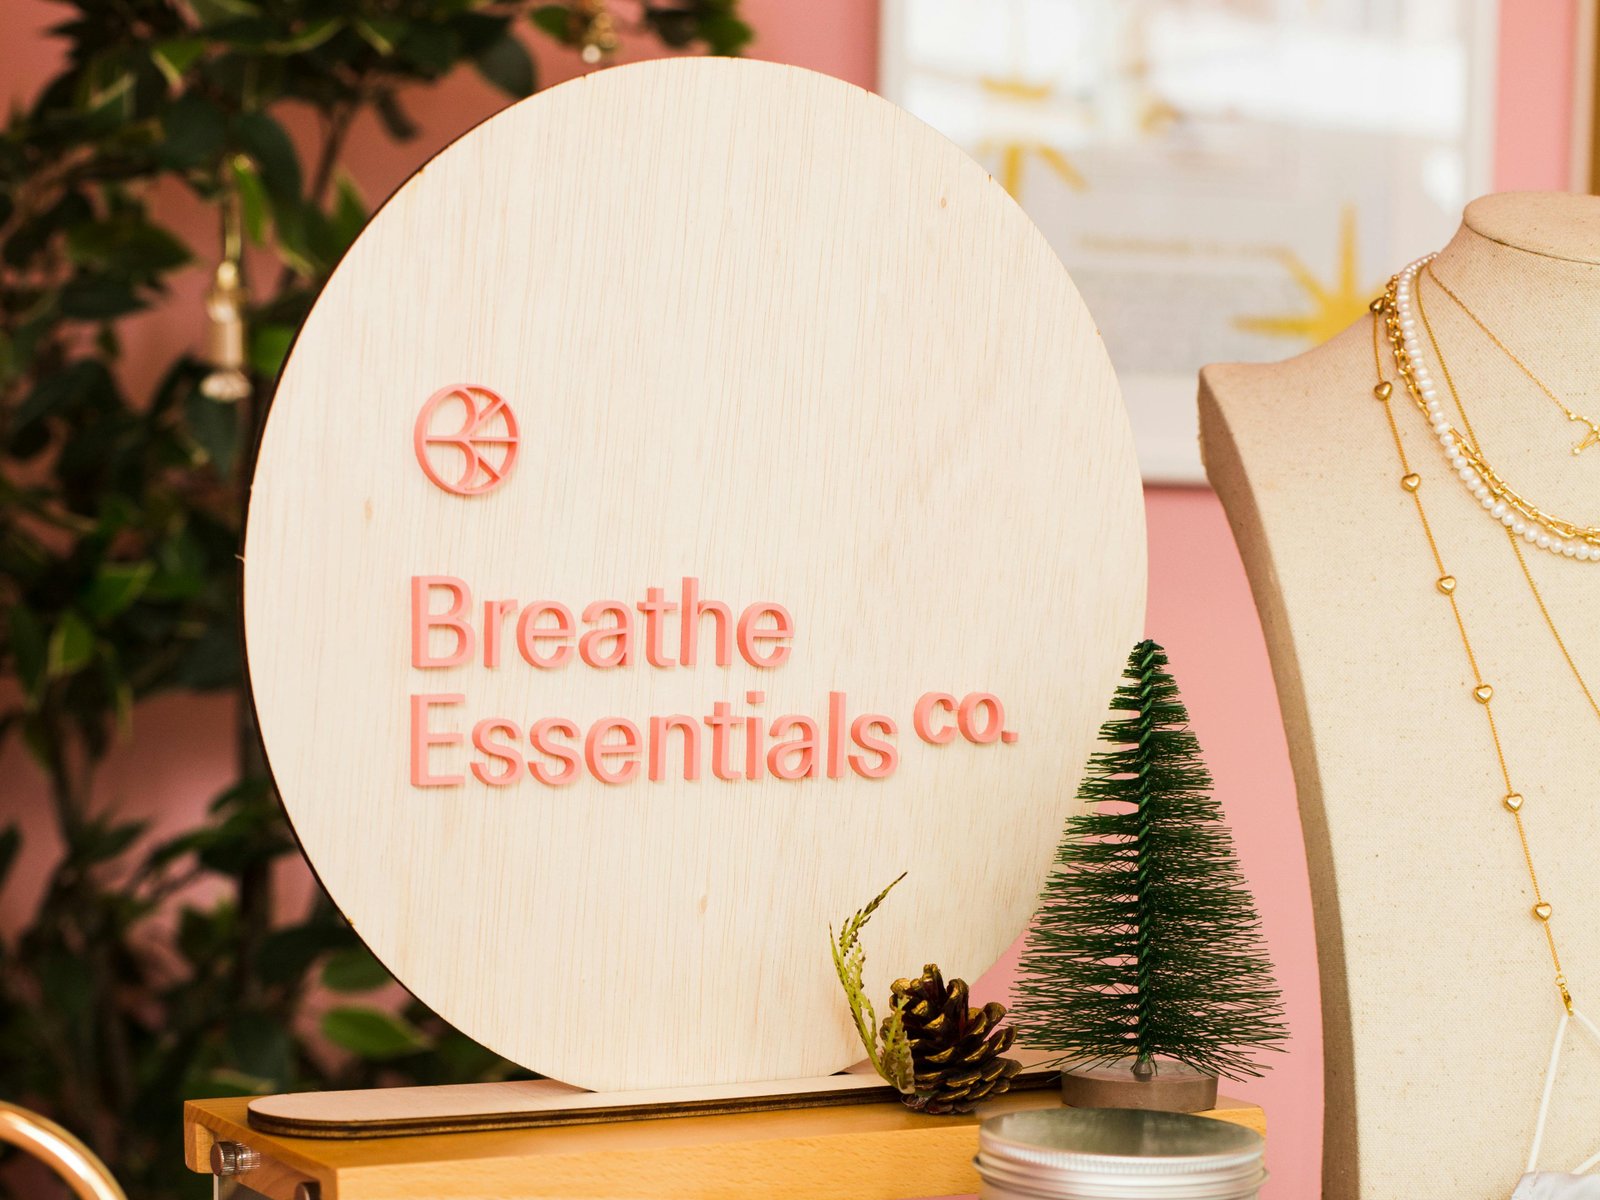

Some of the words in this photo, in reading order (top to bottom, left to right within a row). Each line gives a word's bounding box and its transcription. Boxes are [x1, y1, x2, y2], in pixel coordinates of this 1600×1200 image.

[410, 575, 794, 667] Breathe
[409, 690, 898, 787] Essentials
[913, 691, 1019, 744] co.
